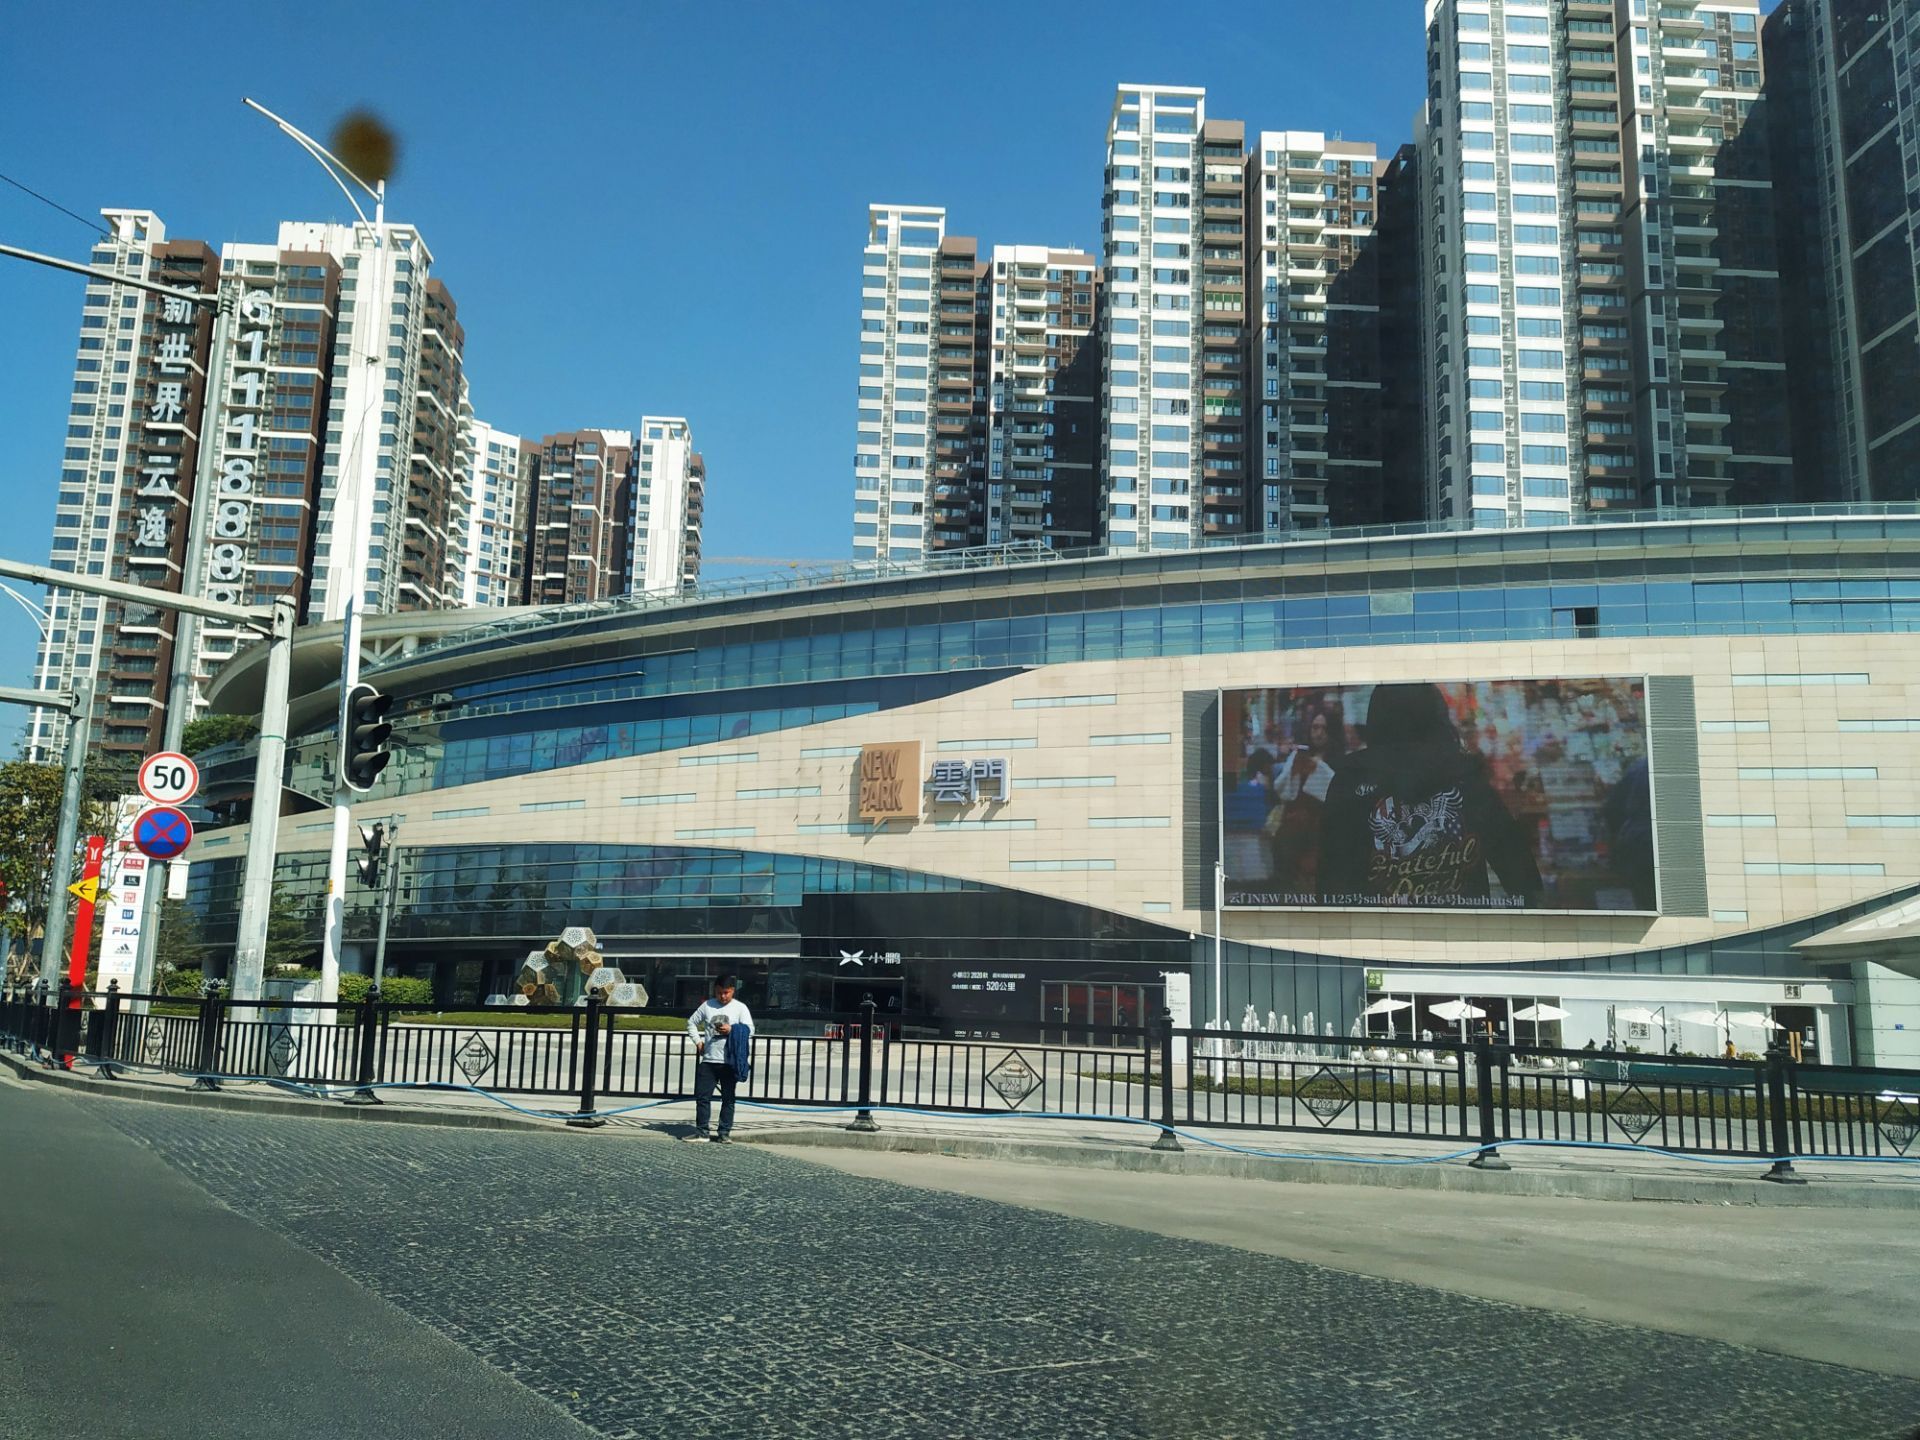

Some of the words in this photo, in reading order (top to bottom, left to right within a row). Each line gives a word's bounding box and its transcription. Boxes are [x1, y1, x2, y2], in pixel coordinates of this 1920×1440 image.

[153, 765, 186, 791] 50
[860, 749, 899, 780] NEW
[859, 779, 903, 811] PARK
[932, 757, 1009, 805] 雲門
[1368, 838, 1476, 881] Grateful
[1284, 893, 1317, 904] PARK
[112, 926, 139, 936] FILA
